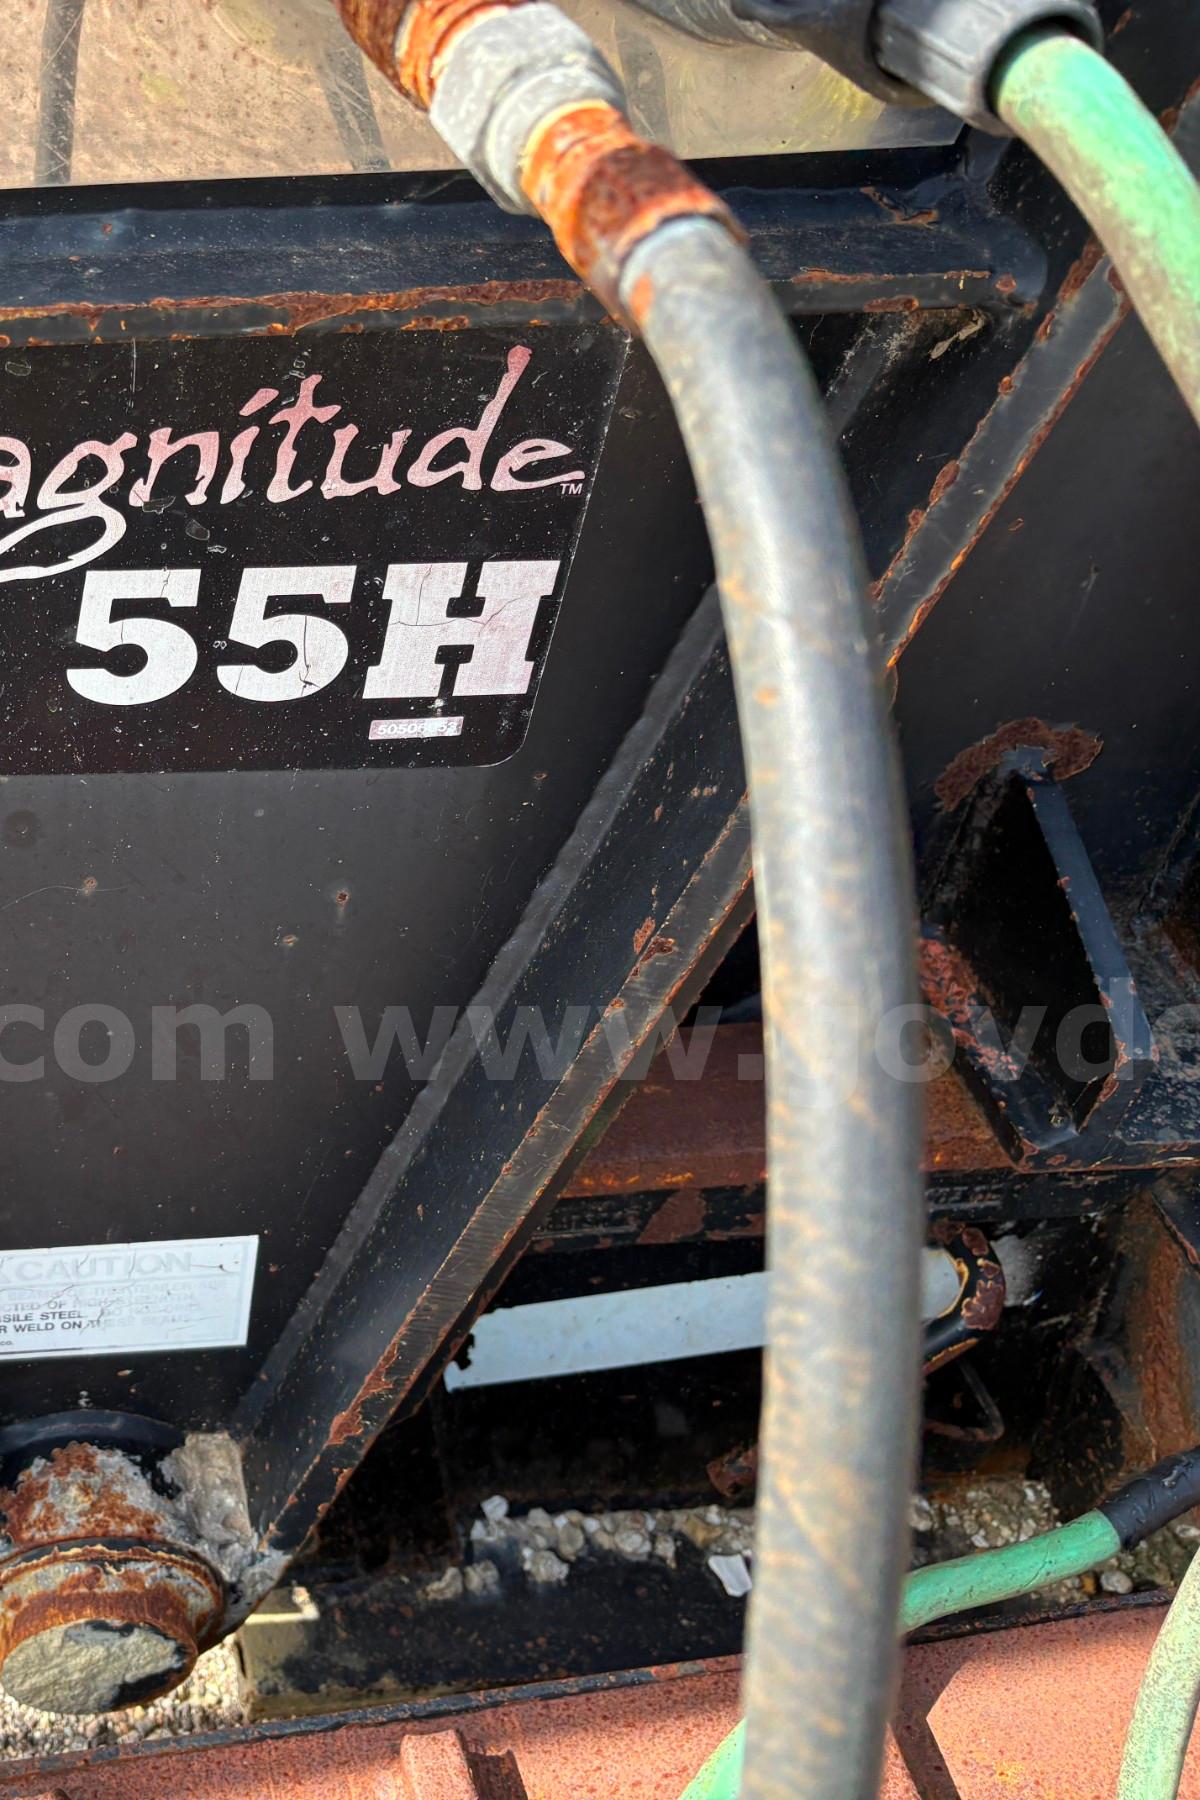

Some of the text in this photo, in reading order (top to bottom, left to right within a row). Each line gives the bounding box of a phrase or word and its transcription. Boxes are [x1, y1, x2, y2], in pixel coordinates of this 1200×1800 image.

[559, 482, 583, 495] TM
[65, 559, 561, 706] 55H
[377, 721, 459, 736] 5050653
[14, 1252, 192, 1282] CAUTION
[13, 1321, 55, 1332] WELD
[60, 1320, 83, 1330] ON
